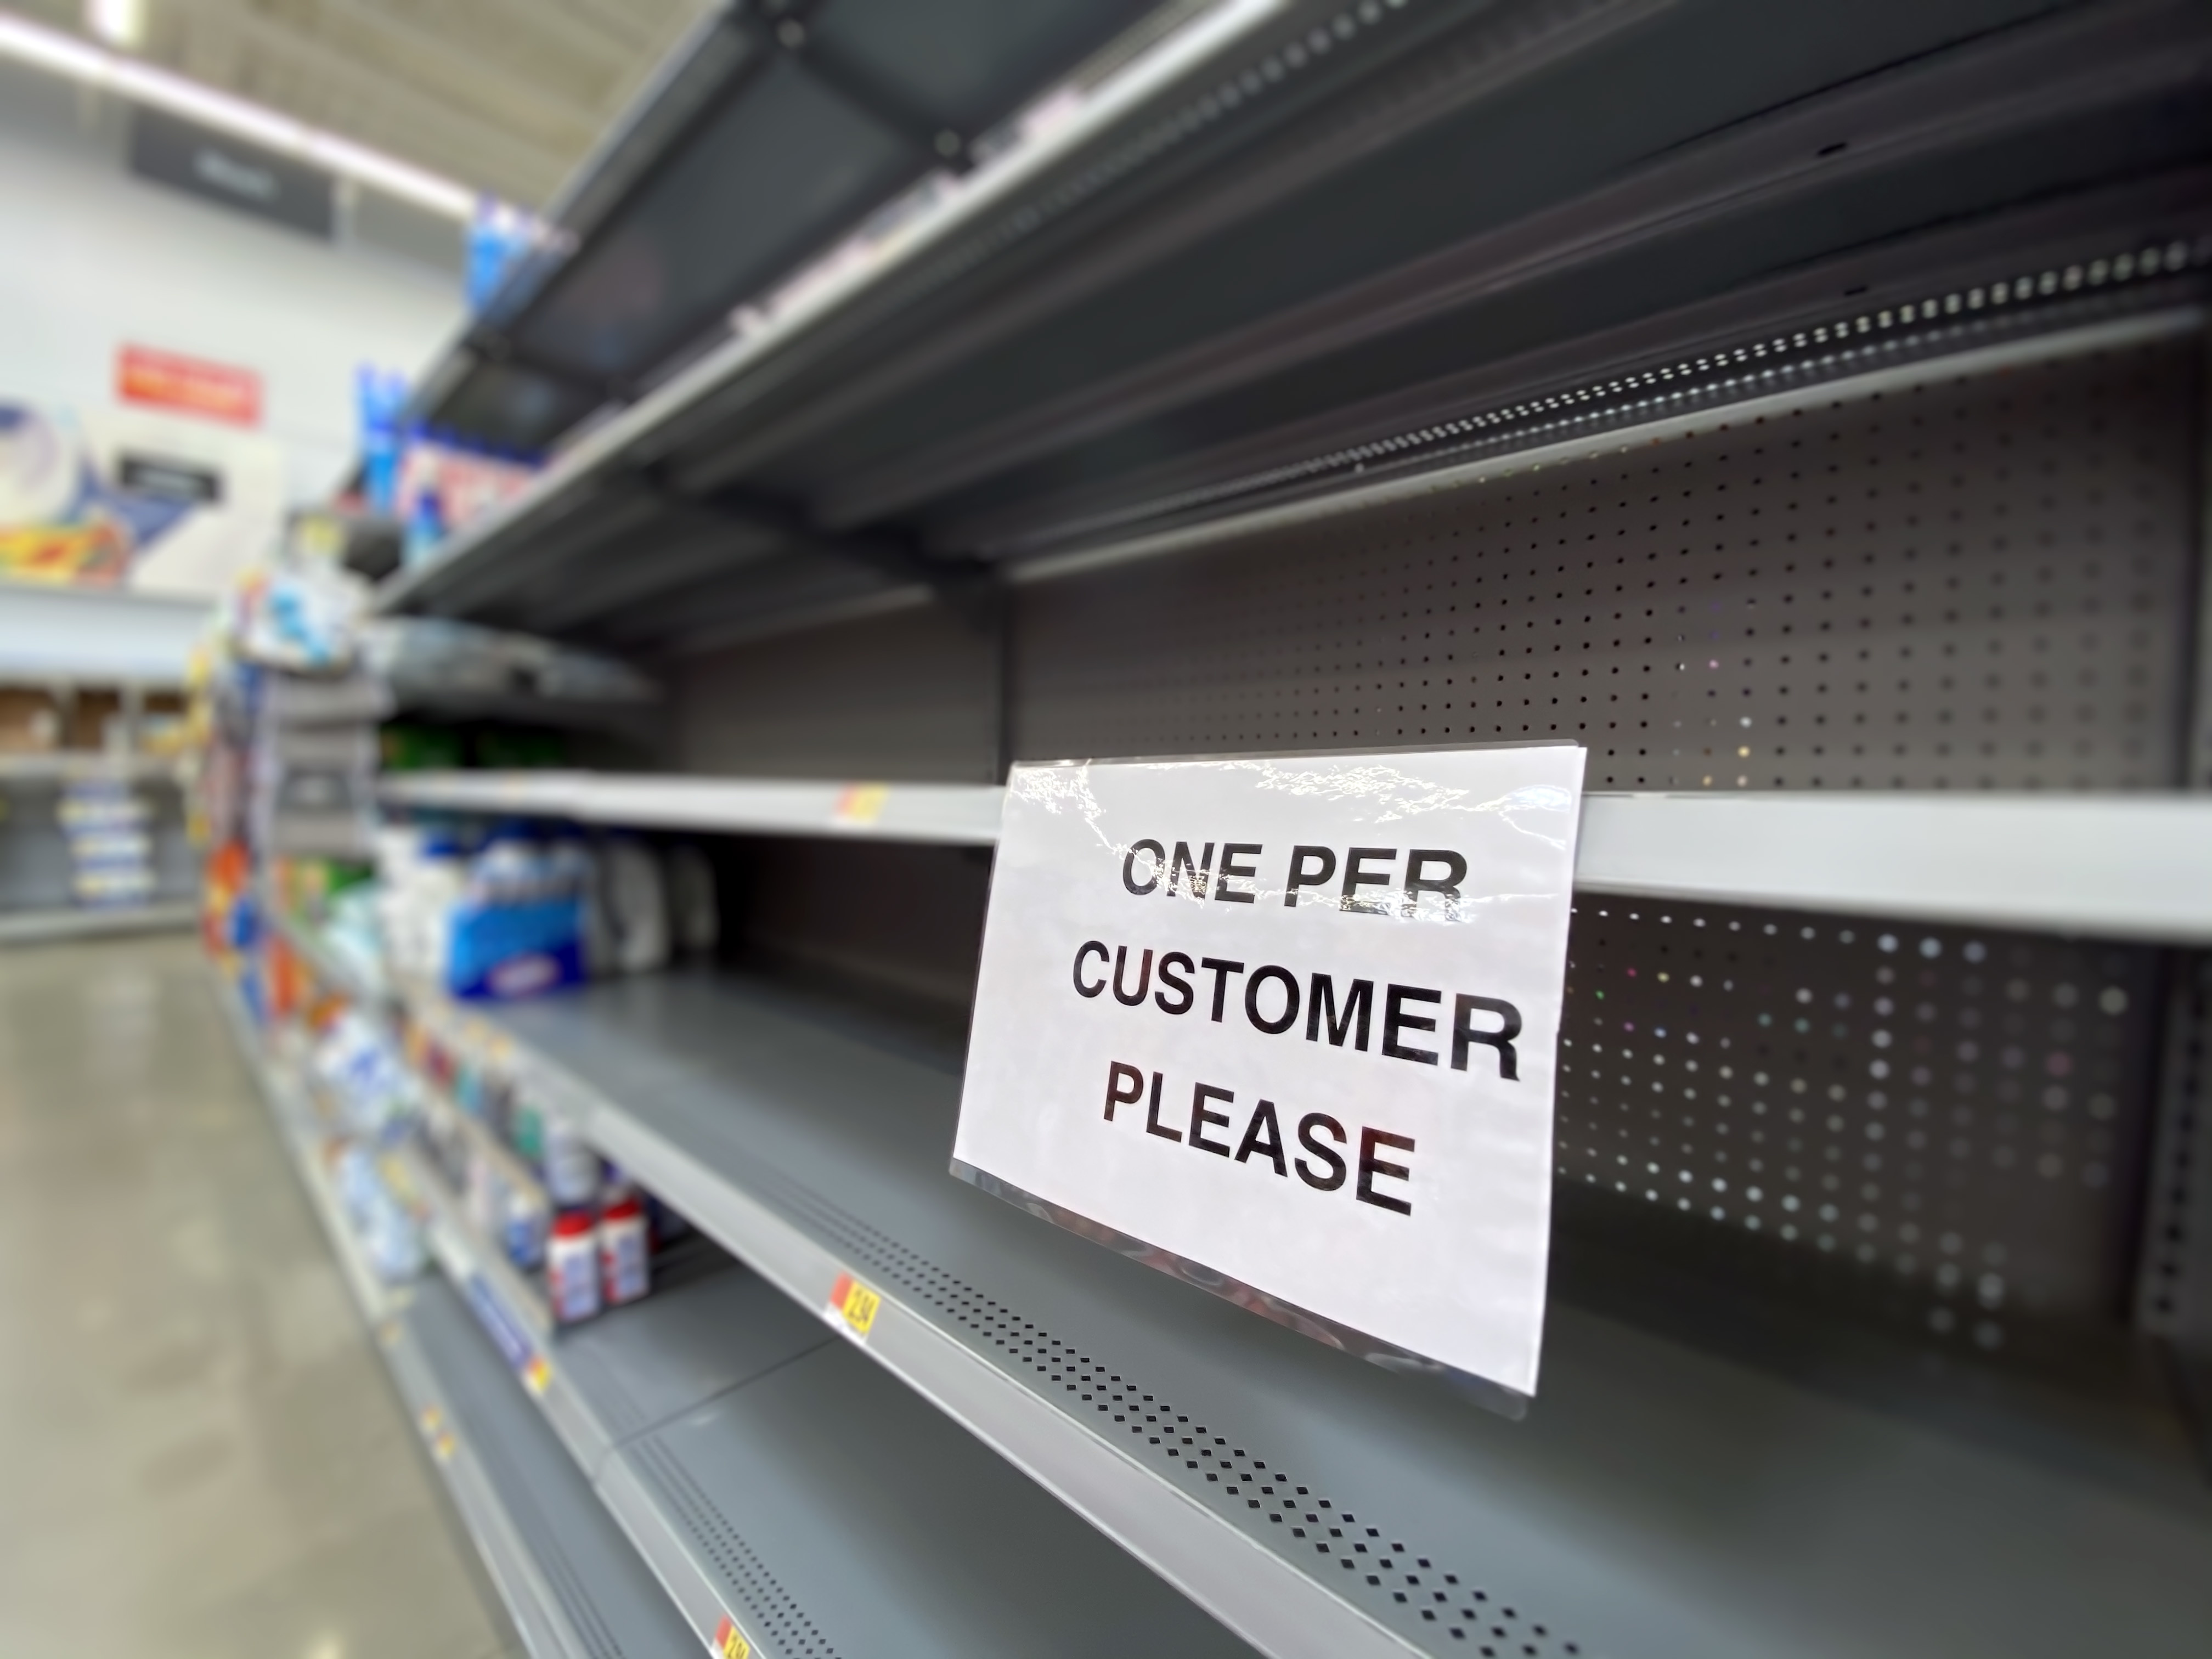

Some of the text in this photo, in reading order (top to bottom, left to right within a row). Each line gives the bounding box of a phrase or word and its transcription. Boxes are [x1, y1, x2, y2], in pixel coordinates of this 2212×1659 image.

[1122, 839, 1467, 922] ONE PER
[1073, 940, 1521, 1081] CUSTOMER
[1103, 1061, 1415, 1216] PLEASE
